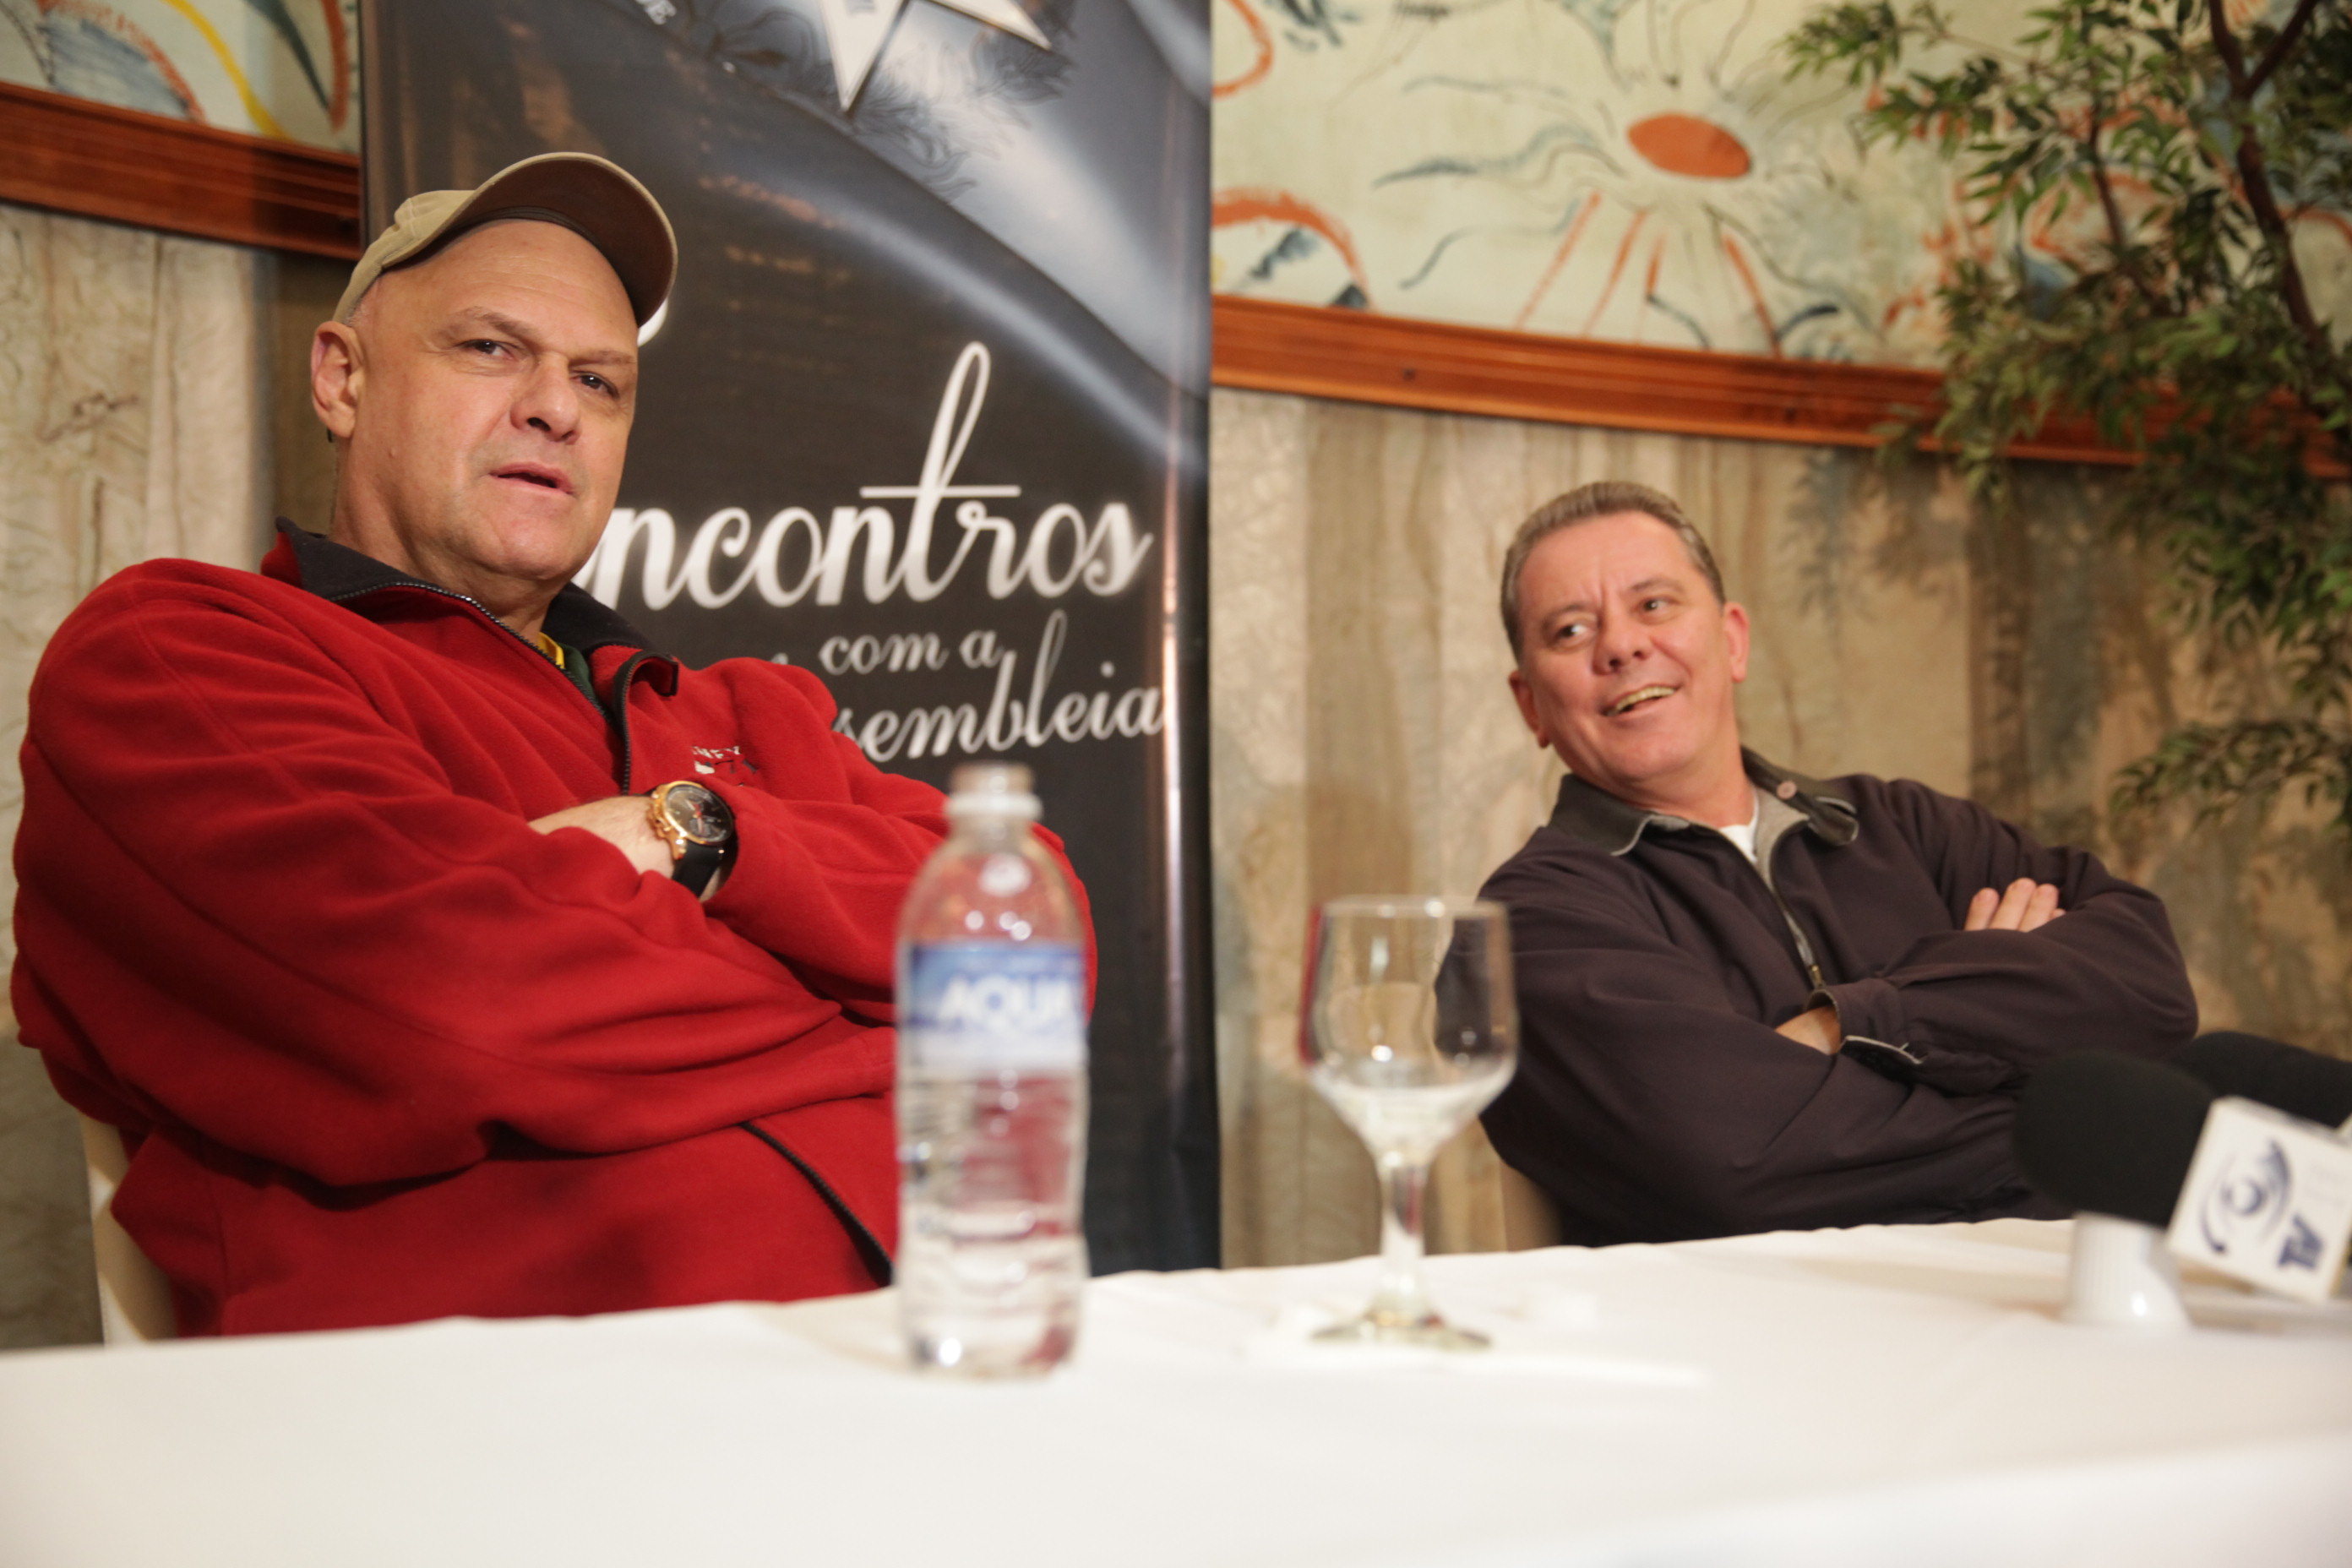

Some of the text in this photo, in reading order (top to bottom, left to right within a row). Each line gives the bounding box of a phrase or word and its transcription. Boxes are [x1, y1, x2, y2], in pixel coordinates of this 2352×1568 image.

[572, 341, 1153, 610] ncontros
[771, 609, 1166, 762] sembleia
[818, 629, 1005, 676] com a
